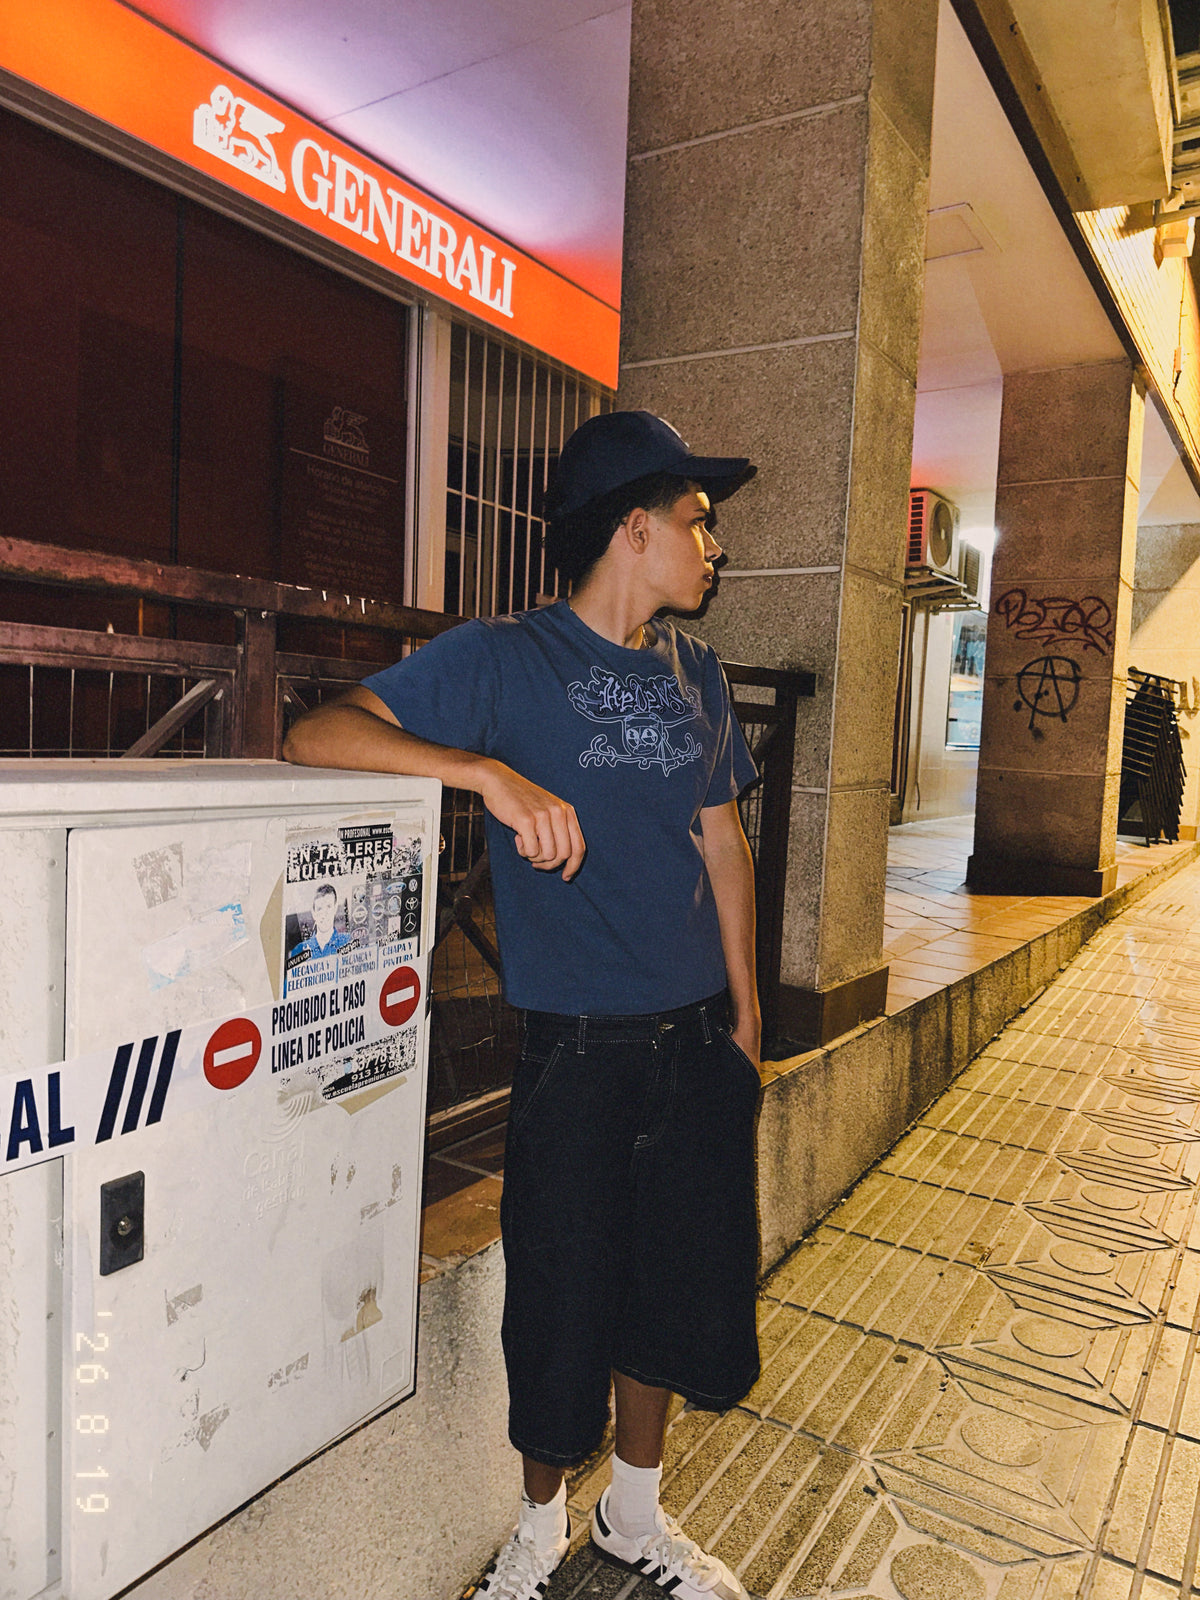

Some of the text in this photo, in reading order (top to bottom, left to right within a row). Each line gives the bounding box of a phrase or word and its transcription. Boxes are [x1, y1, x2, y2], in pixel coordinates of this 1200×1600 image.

[291, 138, 516, 318] GENERALI
[323, 443, 369, 467] GENERALI
[344, 826, 371, 839] PROFESIONAL
[288, 854, 392, 881] MULTIMARCA
[382, 943, 407, 956] CHAPA
[383, 953, 414, 969] PINTURA
[287, 971, 335, 992] ELECTRICIDAD
[272, 979, 366, 1036] PROHIBIDO EL PASO
[272, 1036, 304, 1074] LINEA
[307, 1029, 322, 1060] DE
[325, 1014, 366, 1054] POLICIA
[351, 1069, 371, 1083] 913
[374, 1063, 386, 1075] 17
[0, 1071, 75, 1162] AL
